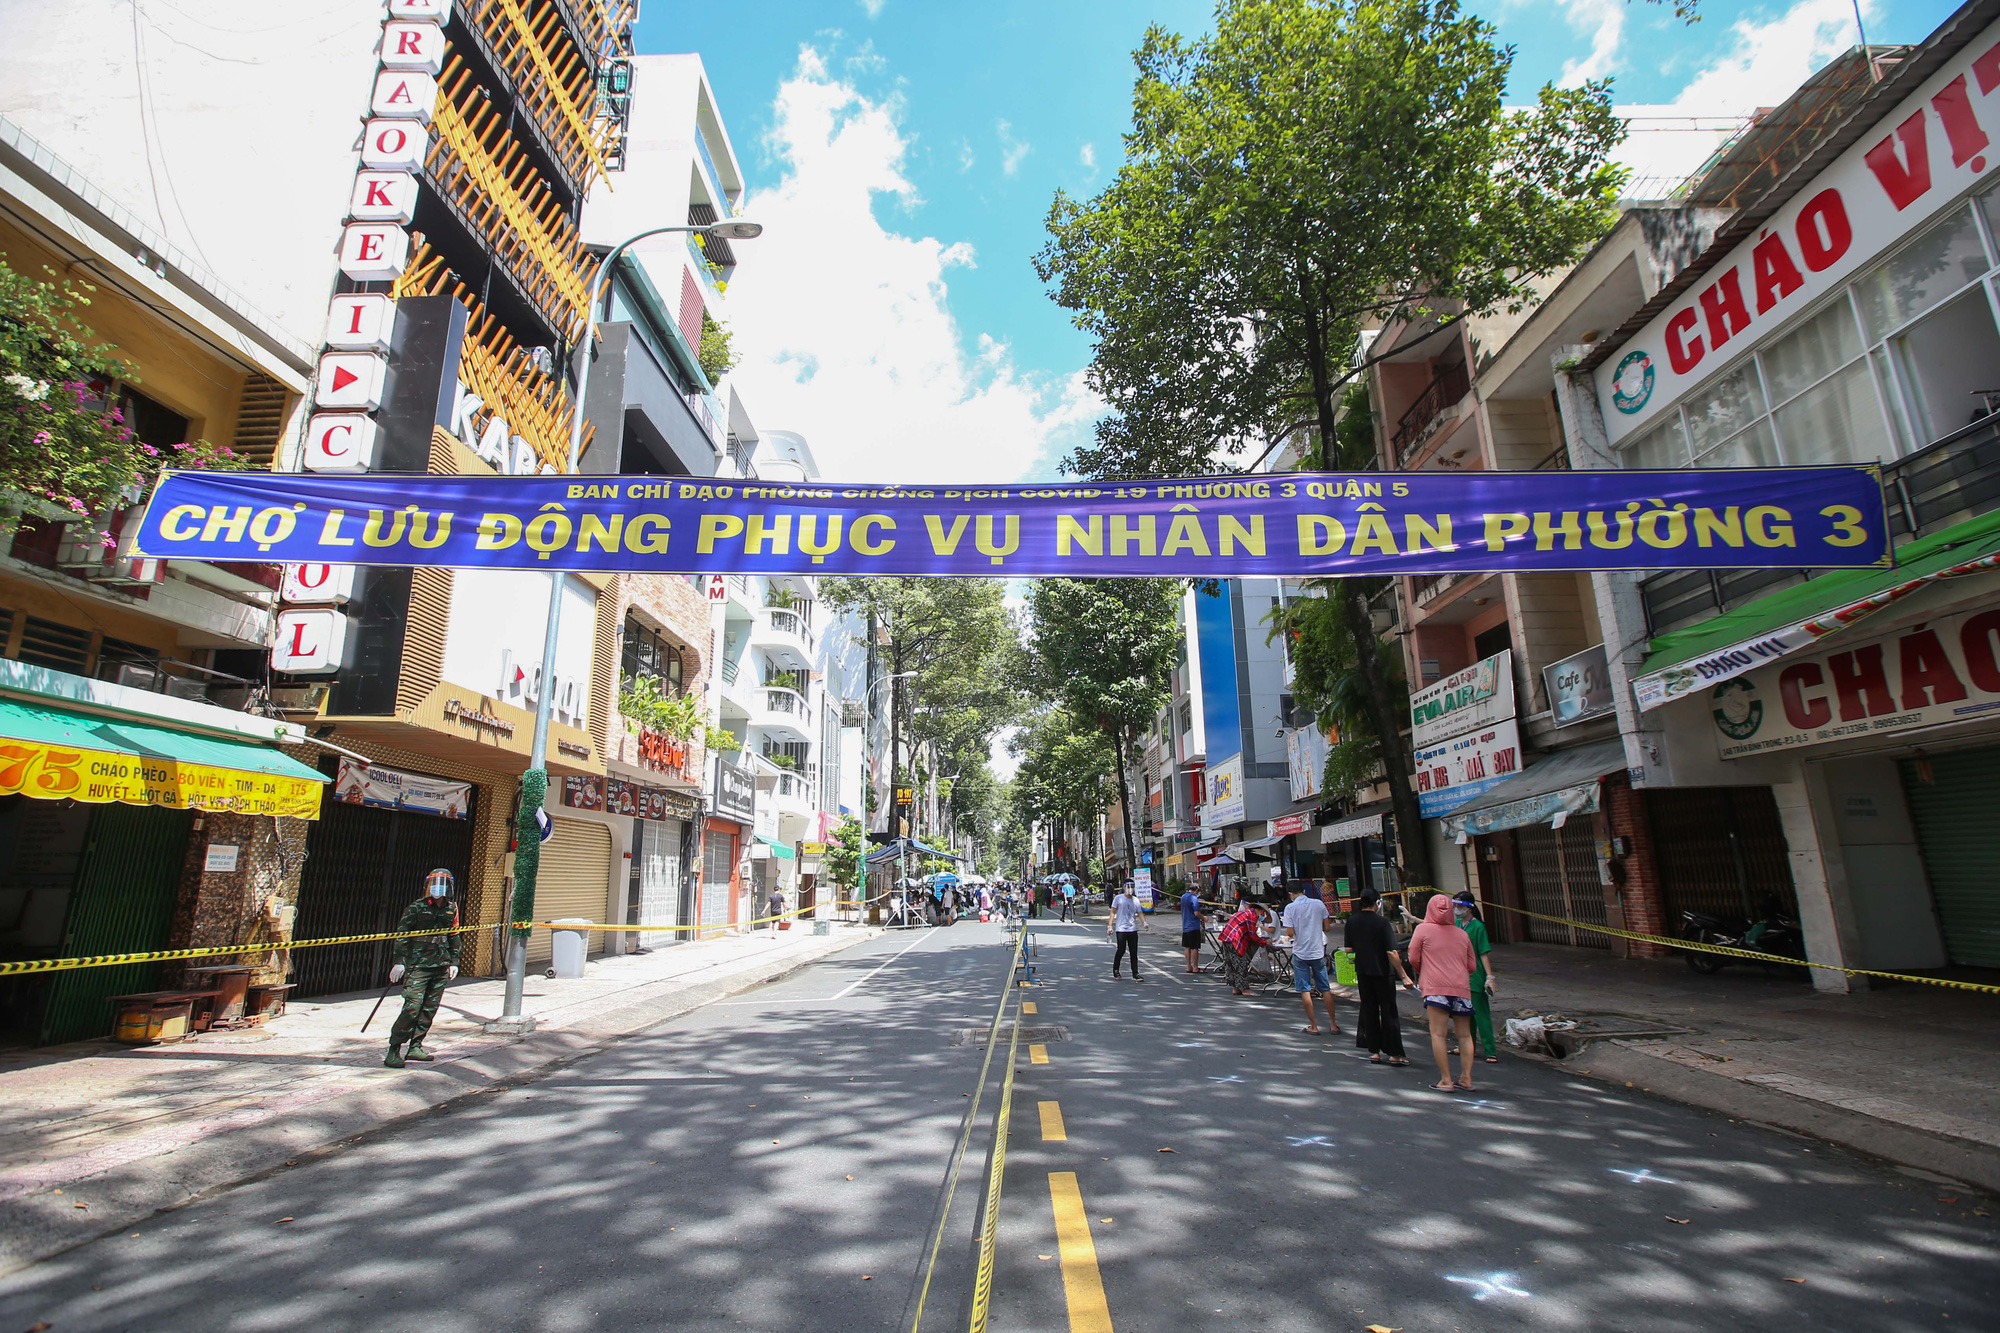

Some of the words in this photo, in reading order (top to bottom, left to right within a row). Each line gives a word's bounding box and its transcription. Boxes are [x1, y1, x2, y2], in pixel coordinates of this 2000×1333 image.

[1665, 188, 1852, 375] CHÁO
[566, 484, 620, 498] BAN
[627, 481, 671, 499] CHỈ
[679, 485, 734, 502] ĐẠO
[742, 484, 833, 498] PHÒNG
[842, 485, 935, 499] CHỐNG
[944, 489, 1008, 502] DỊCH
[1019, 487, 1147, 499] COVID-19
[1157, 482, 1271, 499] PHƯỜNG
[1279, 483, 1297, 498] 3
[1306, 480, 1382, 501] QUẬN
[1391, 483, 1409, 497] 5
[159, 501, 307, 546] CHỢ
[319, 504, 454, 548] LƯU
[475, 502, 672, 560] ĐỘNG
[696, 514, 897, 564] PHỤC
[923, 514, 1020, 565] VỤ
[1057, 503, 1268, 556] NHÂN
[1297, 502, 1456, 555] DÂN
[1484, 498, 1797, 553] PHƯỜNG
[1818, 504, 1868, 548] 3
[1695, 650, 1753, 680] CHÁO
[1558, 671, 1580, 691] Cafe
[1413, 698, 1444, 726] EVA
[1444, 685, 1475, 713] AIR
[1493, 747, 1515, 774] BAY
[91, 761, 128, 778] CHÁO
[133, 766, 167, 782] PHÈO
[178, 771, 195, 785] BÒ
[199, 773, 225, 789] VIÊN
[235, 779, 253, 792] TIM
[263, 783, 275, 794] DA
[290, 784, 306, 795] 175
[388, 773, 402, 786] DELI
[88, 781, 129, 799] HUYẾT
[140, 786, 160, 804] HỘT
[163, 788, 176, 804] GÀ
[254, 797, 275, 812] THẢO
[1347, 821, 1359, 832] TEA
